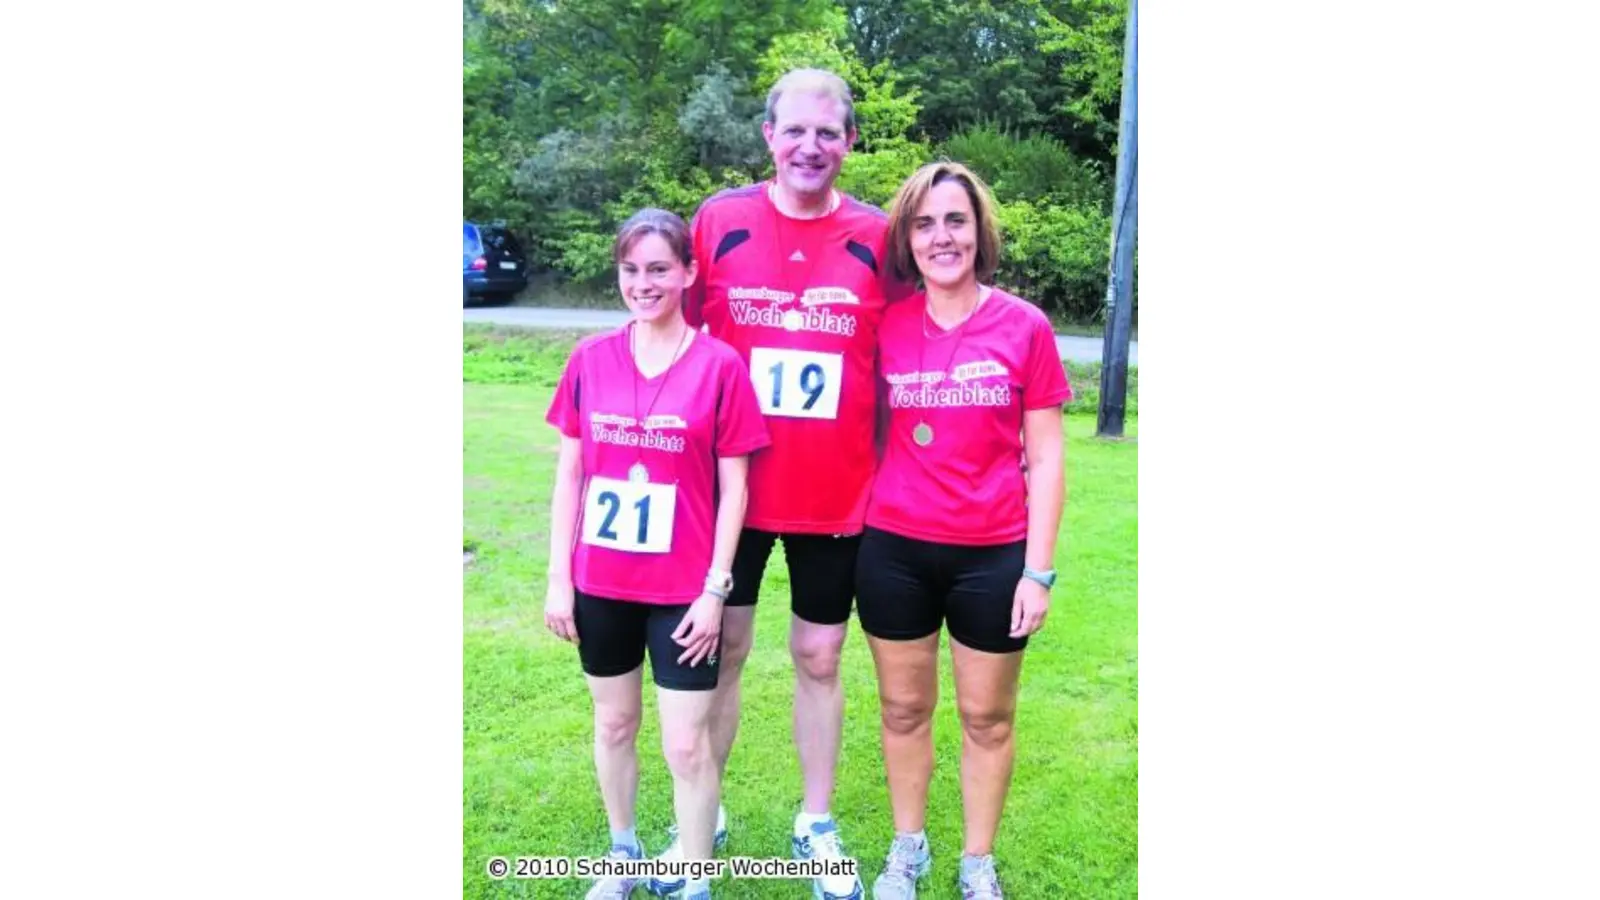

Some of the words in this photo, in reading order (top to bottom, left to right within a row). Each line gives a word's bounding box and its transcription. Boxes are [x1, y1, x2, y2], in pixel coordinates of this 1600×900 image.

[729, 300, 856, 337] Wochnblatt
[768, 361, 826, 411] 19
[597, 491, 651, 544] 21
